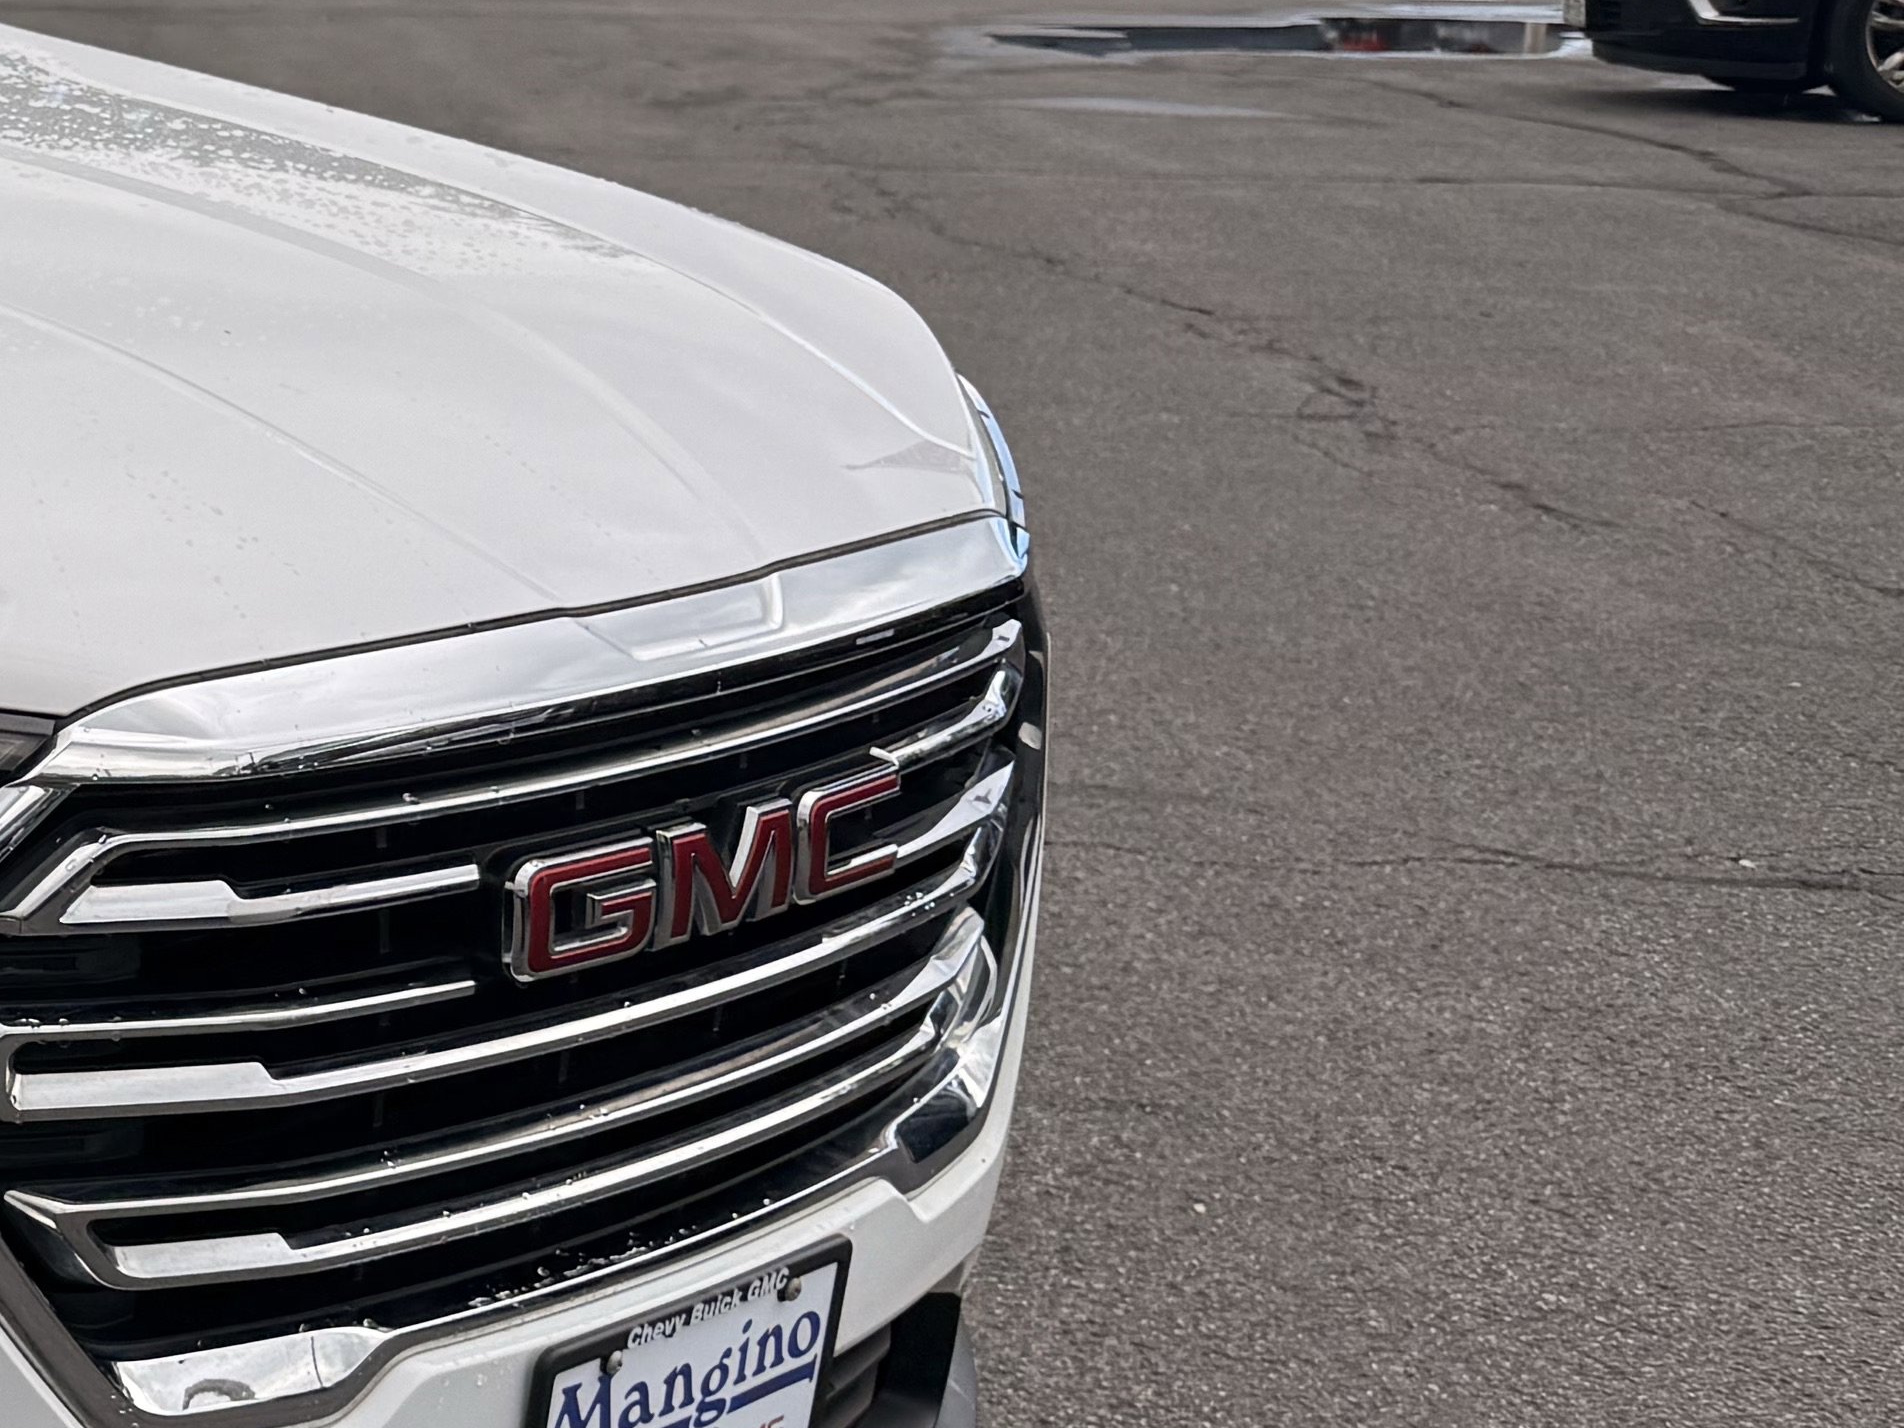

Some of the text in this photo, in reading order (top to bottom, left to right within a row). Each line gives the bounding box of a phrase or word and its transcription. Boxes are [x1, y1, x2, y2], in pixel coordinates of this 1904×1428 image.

[503, 772, 900, 983] GMC
[626, 1267, 790, 1349] Chevy Buick GMC
